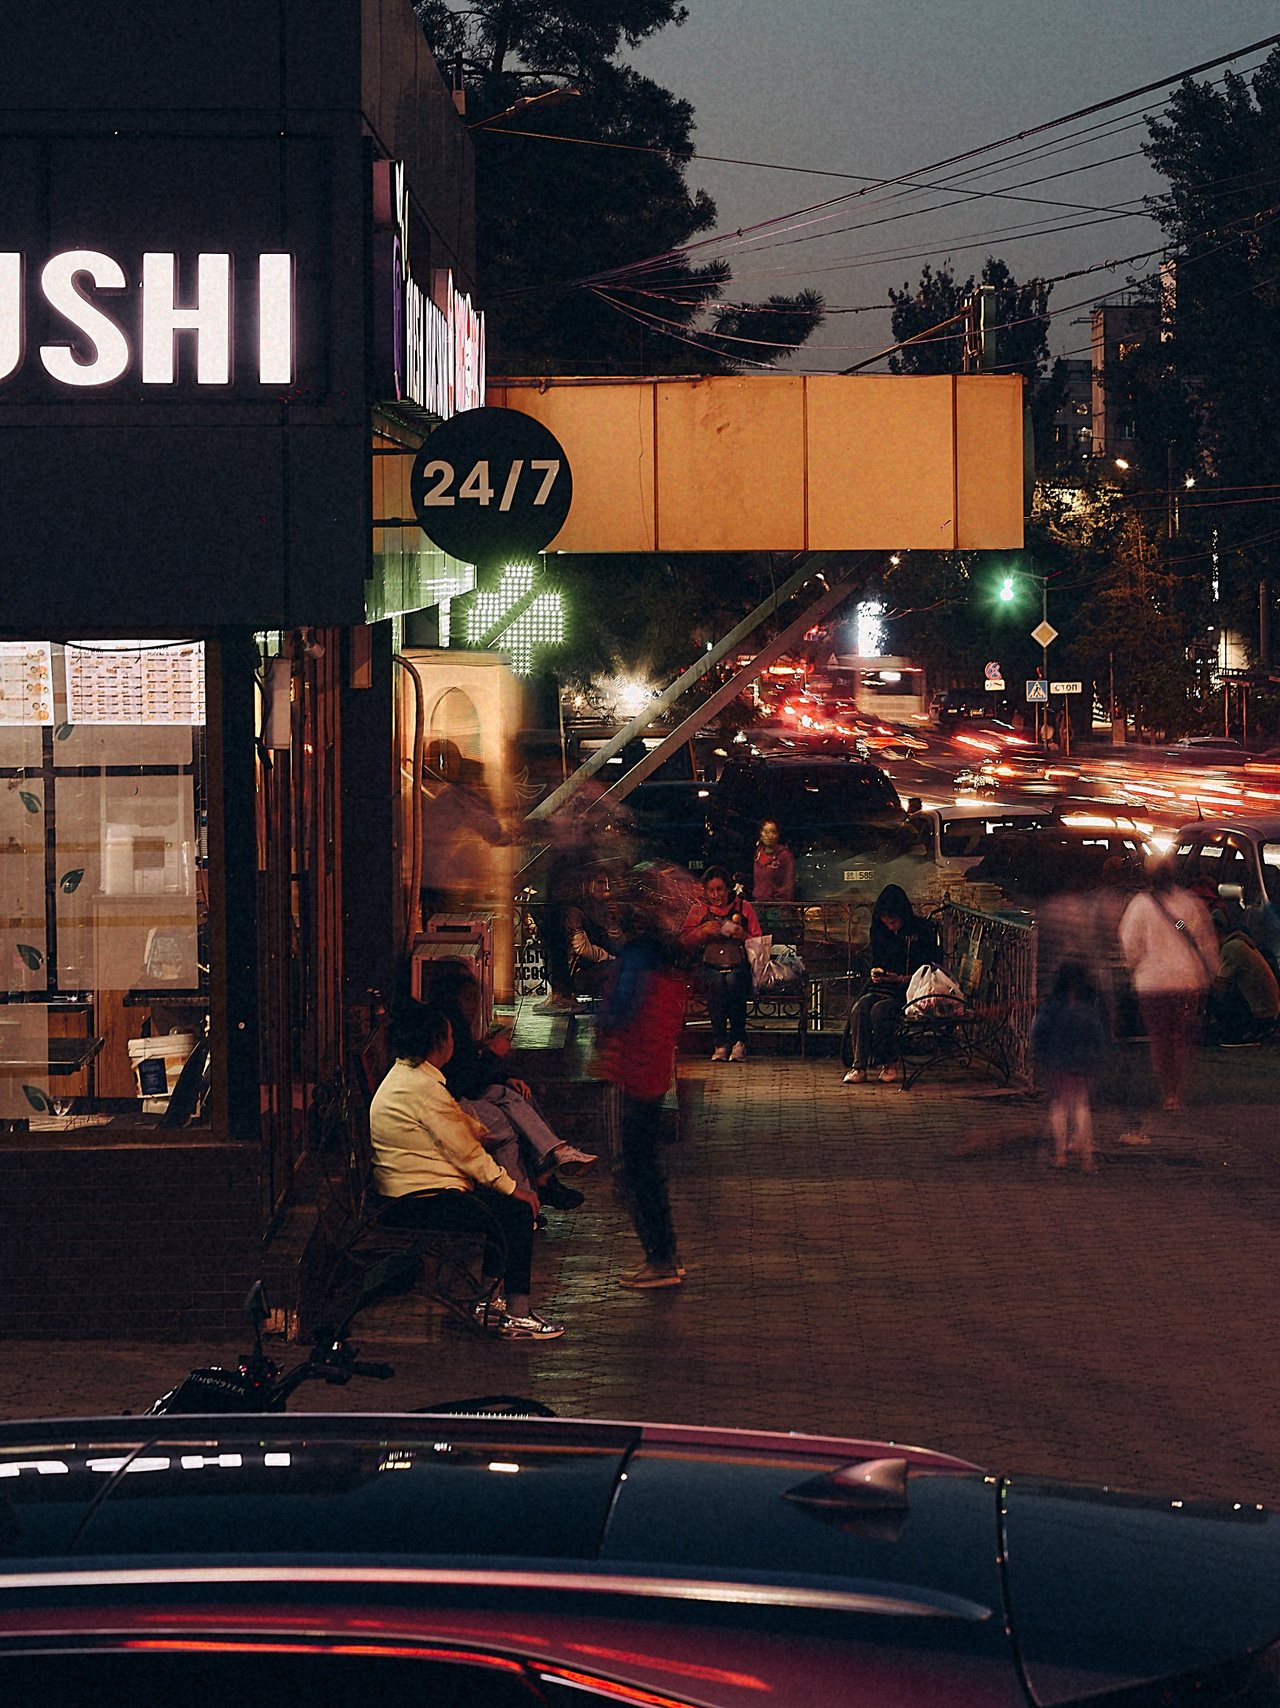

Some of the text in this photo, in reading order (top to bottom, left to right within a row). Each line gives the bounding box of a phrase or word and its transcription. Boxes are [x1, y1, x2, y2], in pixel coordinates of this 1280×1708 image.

[0, 250, 293, 386] SHI
[422, 459, 561, 513] 24/7
[1054, 683, 1078, 692] СТОП
[197, 1376, 246, 1396] MONSTER
